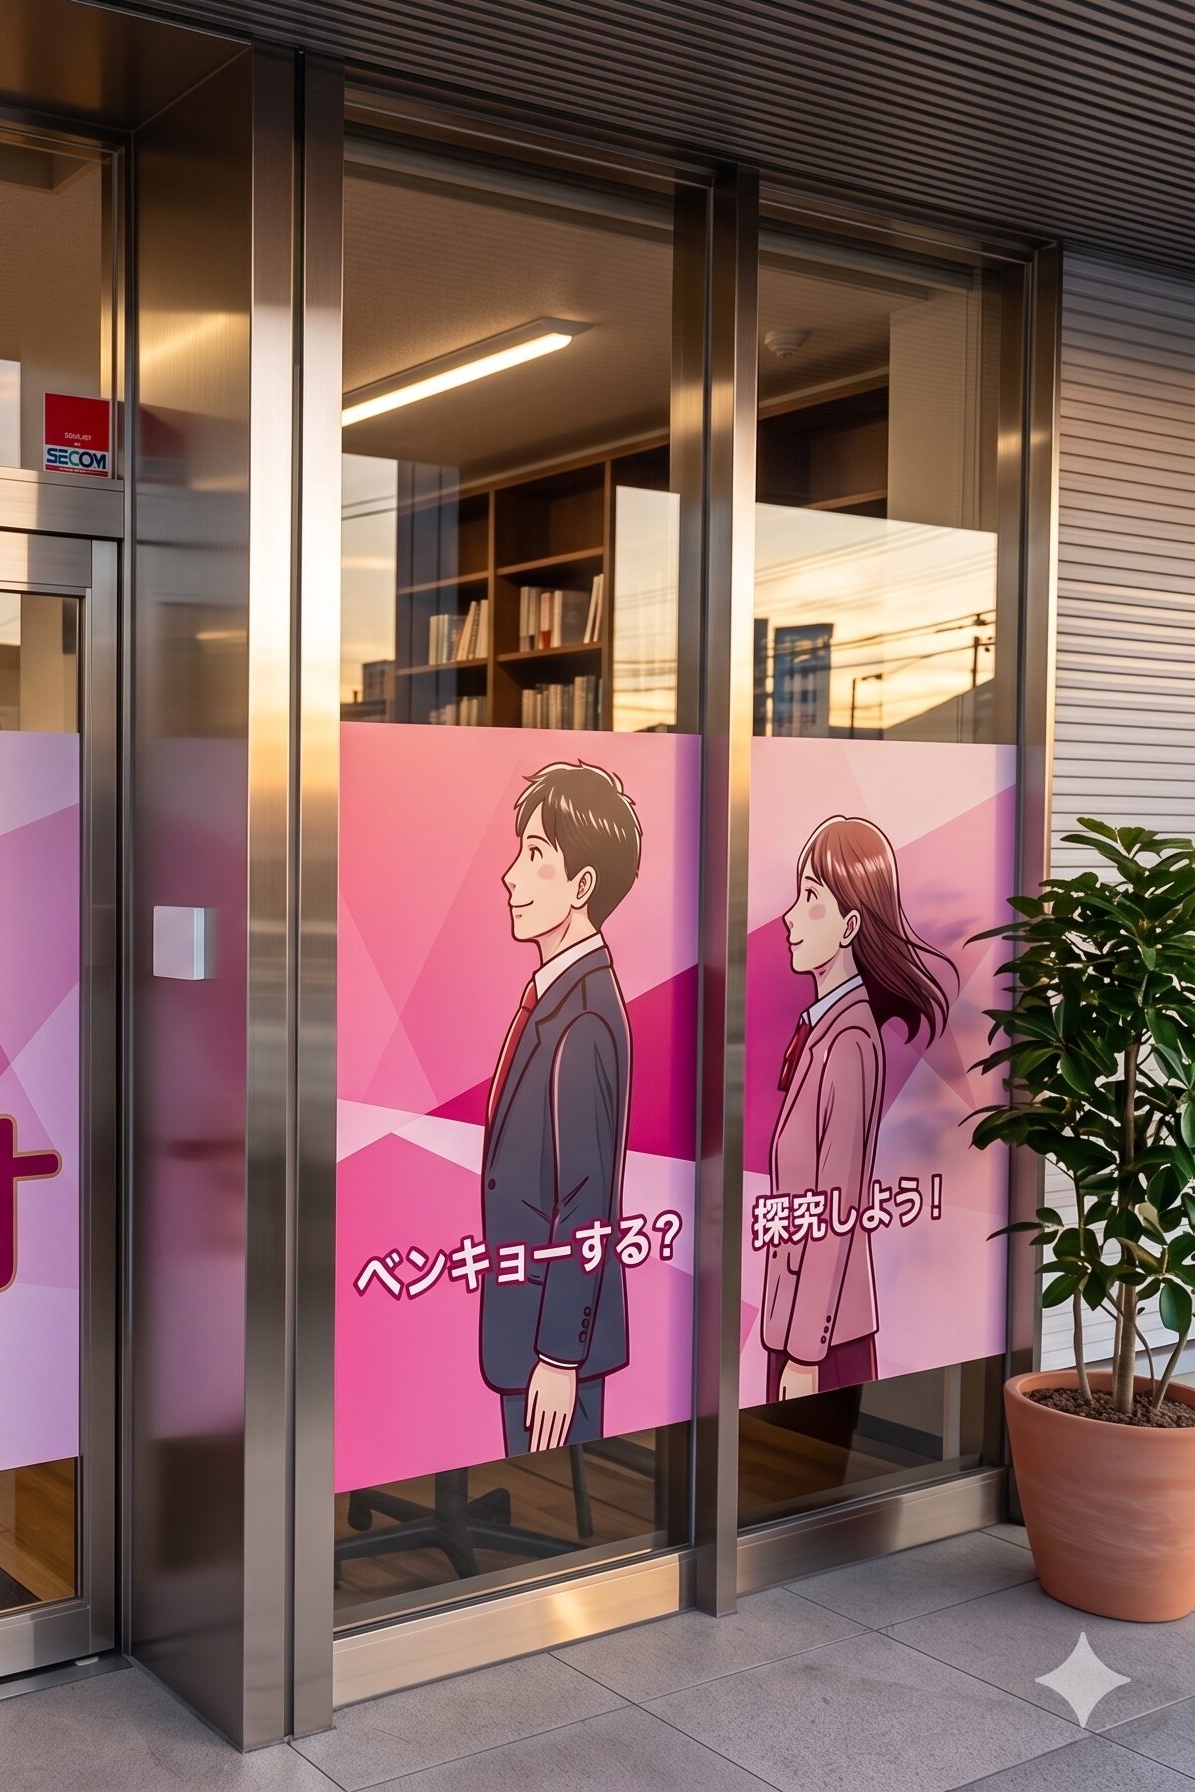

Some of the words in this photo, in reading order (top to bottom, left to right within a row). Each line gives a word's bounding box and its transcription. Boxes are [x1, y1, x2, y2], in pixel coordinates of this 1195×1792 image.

[47, 447, 107, 470] SECOM
[752, 1174, 943, 1251] 探究しよう！
[354, 1210, 683, 1301] ベンキョーする？
